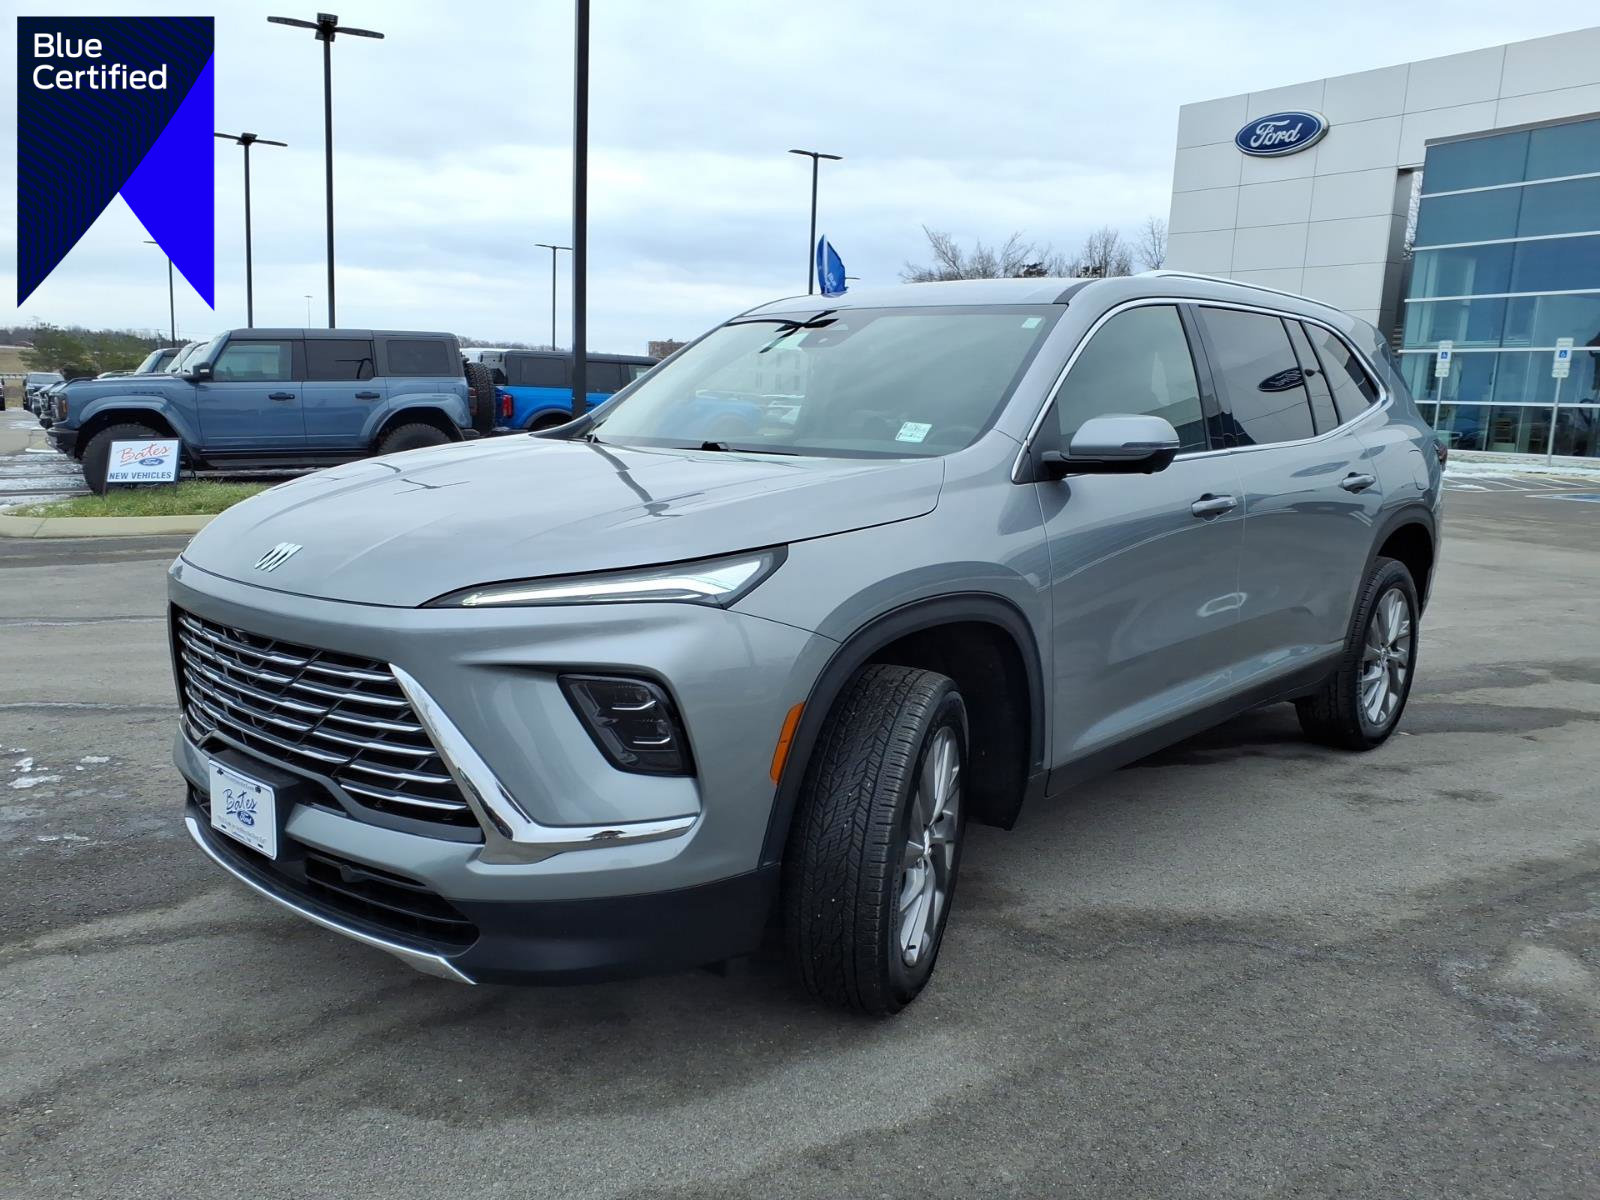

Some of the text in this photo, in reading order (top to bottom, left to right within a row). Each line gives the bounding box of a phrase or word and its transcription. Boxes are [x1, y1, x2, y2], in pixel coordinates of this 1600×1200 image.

[1250, 119, 1303, 147] Ford
[120, 443, 170, 461] Bates
[109, 471, 172, 480] NEW VEHICLES
[223, 788, 257, 811] Bates
